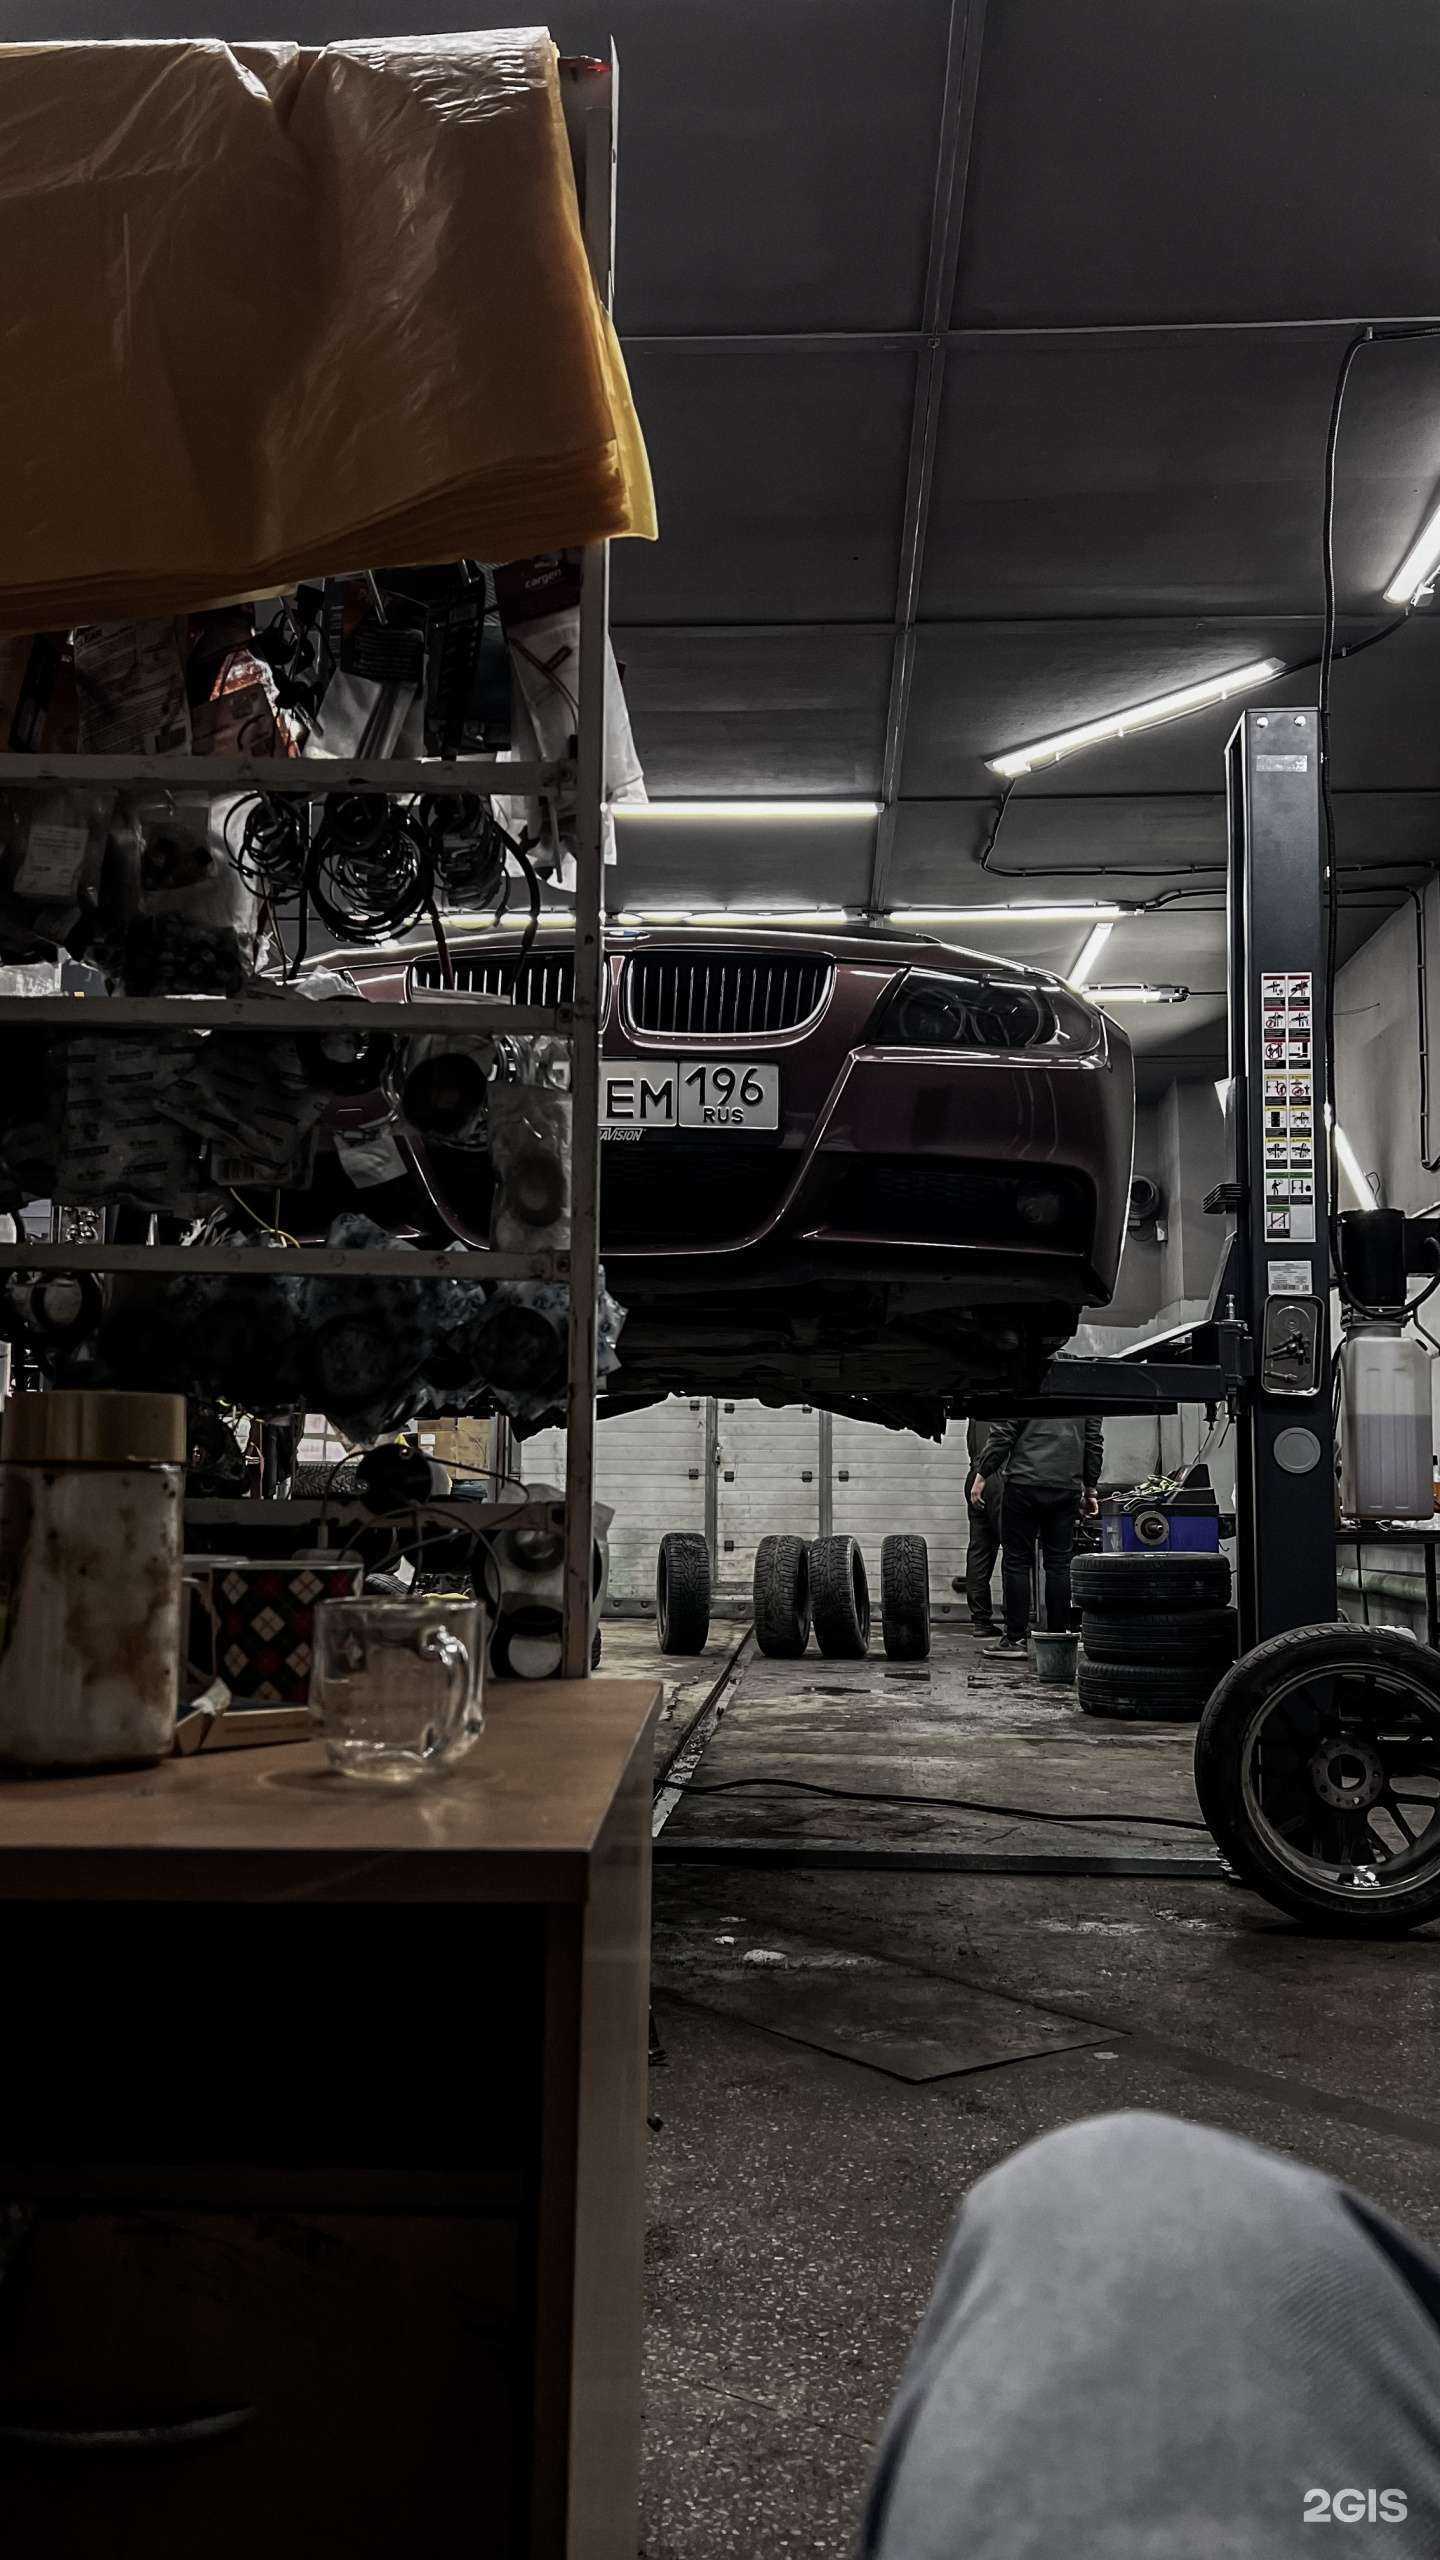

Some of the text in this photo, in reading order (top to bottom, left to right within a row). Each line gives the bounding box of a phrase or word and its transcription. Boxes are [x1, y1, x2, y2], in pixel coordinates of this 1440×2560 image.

[606, 1065, 764, 1119] EM 196
[702, 1106, 745, 1124] RUS
[599, 1127, 643, 1141] AVISION
